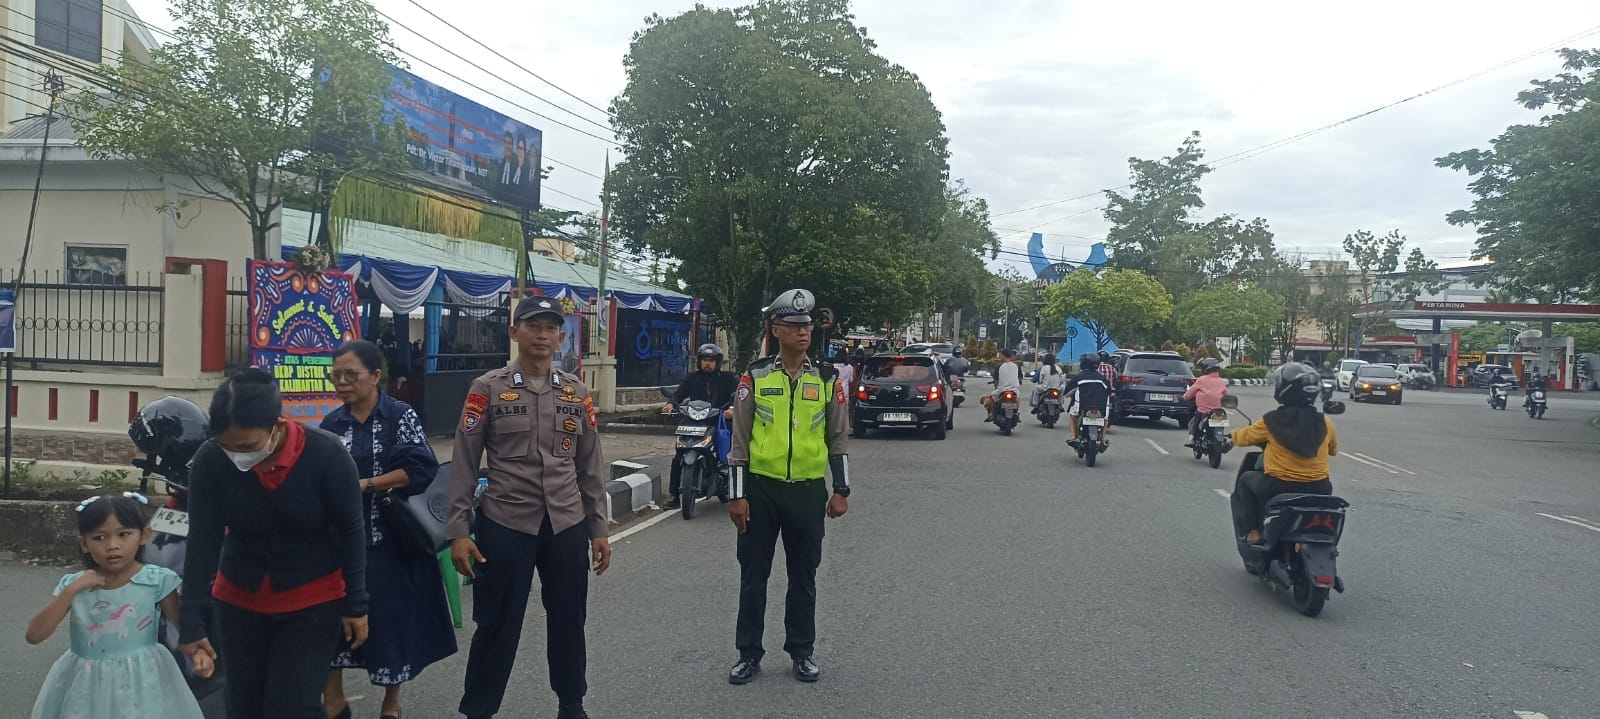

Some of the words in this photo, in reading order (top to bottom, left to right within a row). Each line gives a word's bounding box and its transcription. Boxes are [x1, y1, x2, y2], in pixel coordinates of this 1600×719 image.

[272, 299, 305, 335] Selamat
[307, 300, 315, 313] &
[316, 304, 341, 339] Sukses
[296, 365, 326, 379] DISTRIK
[279, 379, 324, 393] KALIMANTAN
